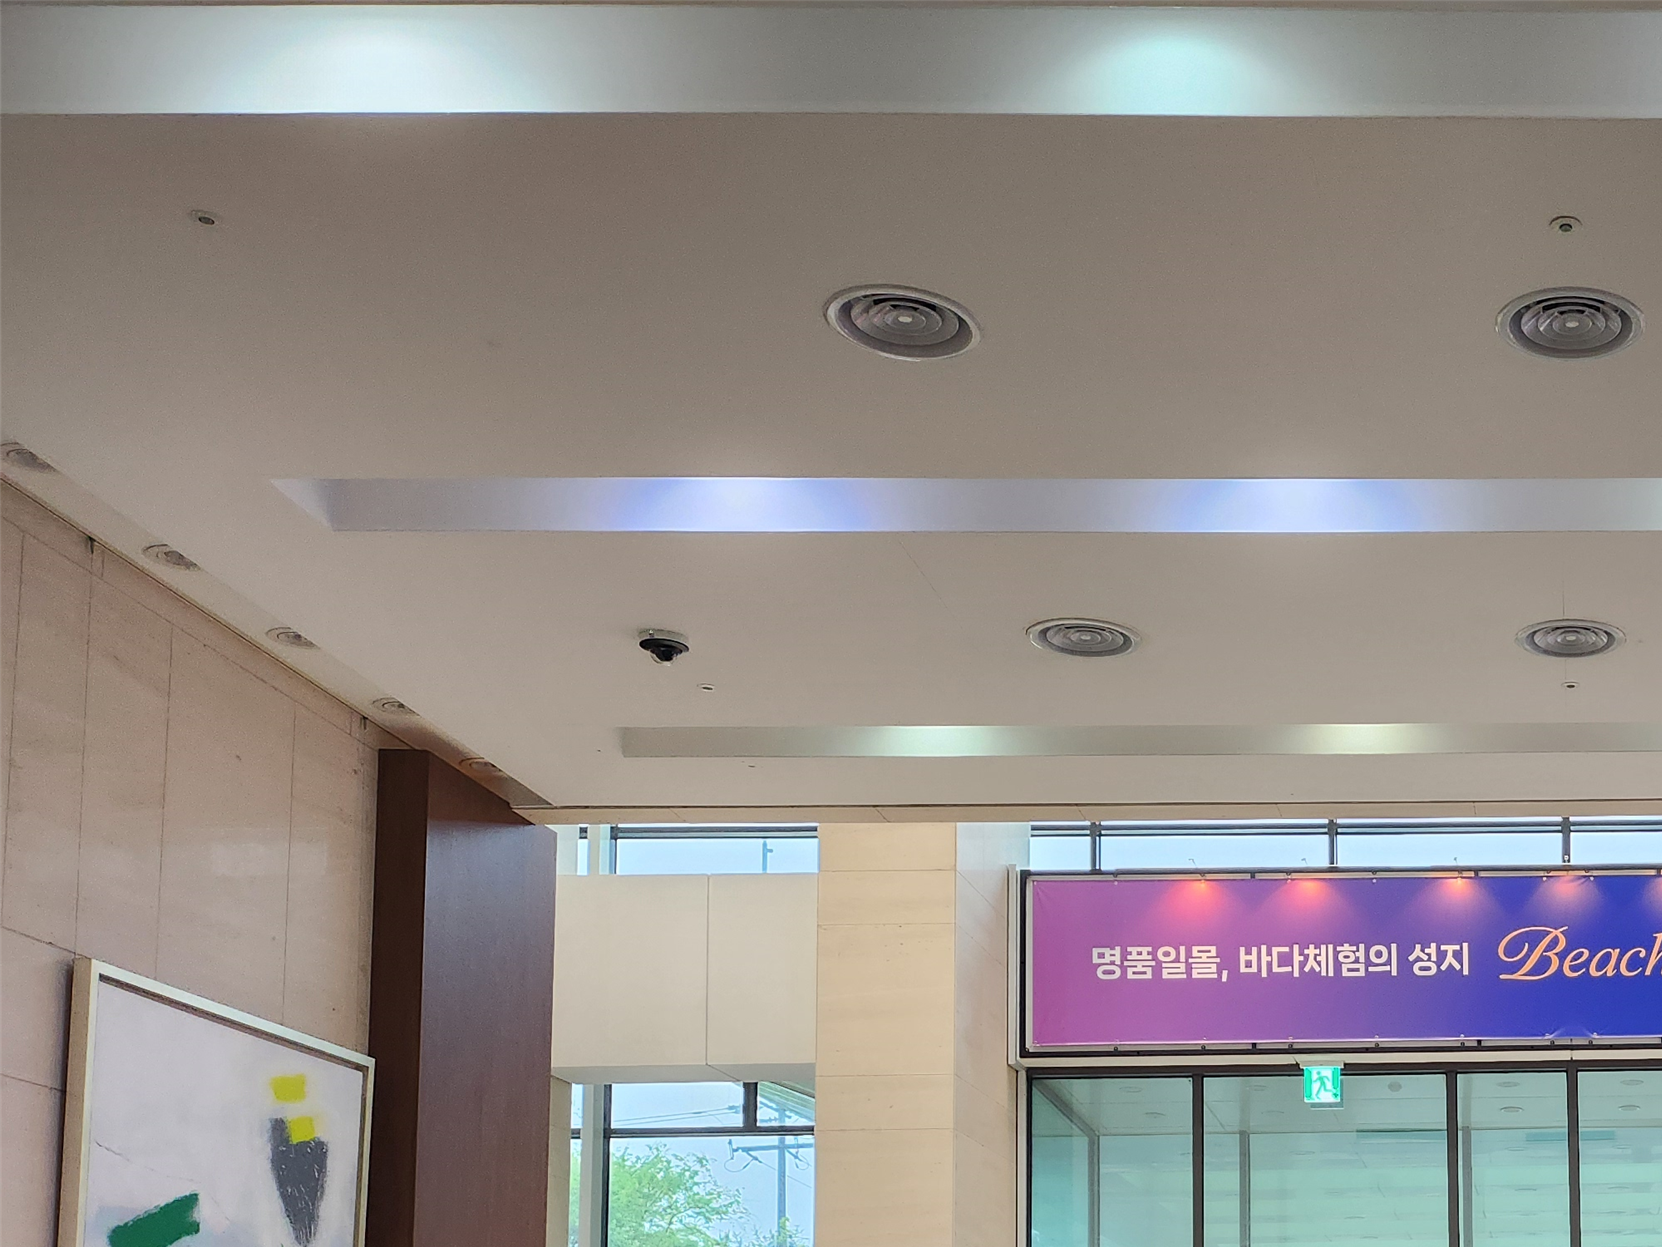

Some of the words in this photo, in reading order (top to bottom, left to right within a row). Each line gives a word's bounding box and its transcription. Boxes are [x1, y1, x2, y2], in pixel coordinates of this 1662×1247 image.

[1091, 945, 1229, 982] 명품일몰,
[1239, 942, 1399, 978] 바다체험의
[1407, 942, 1470, 977] 성지
